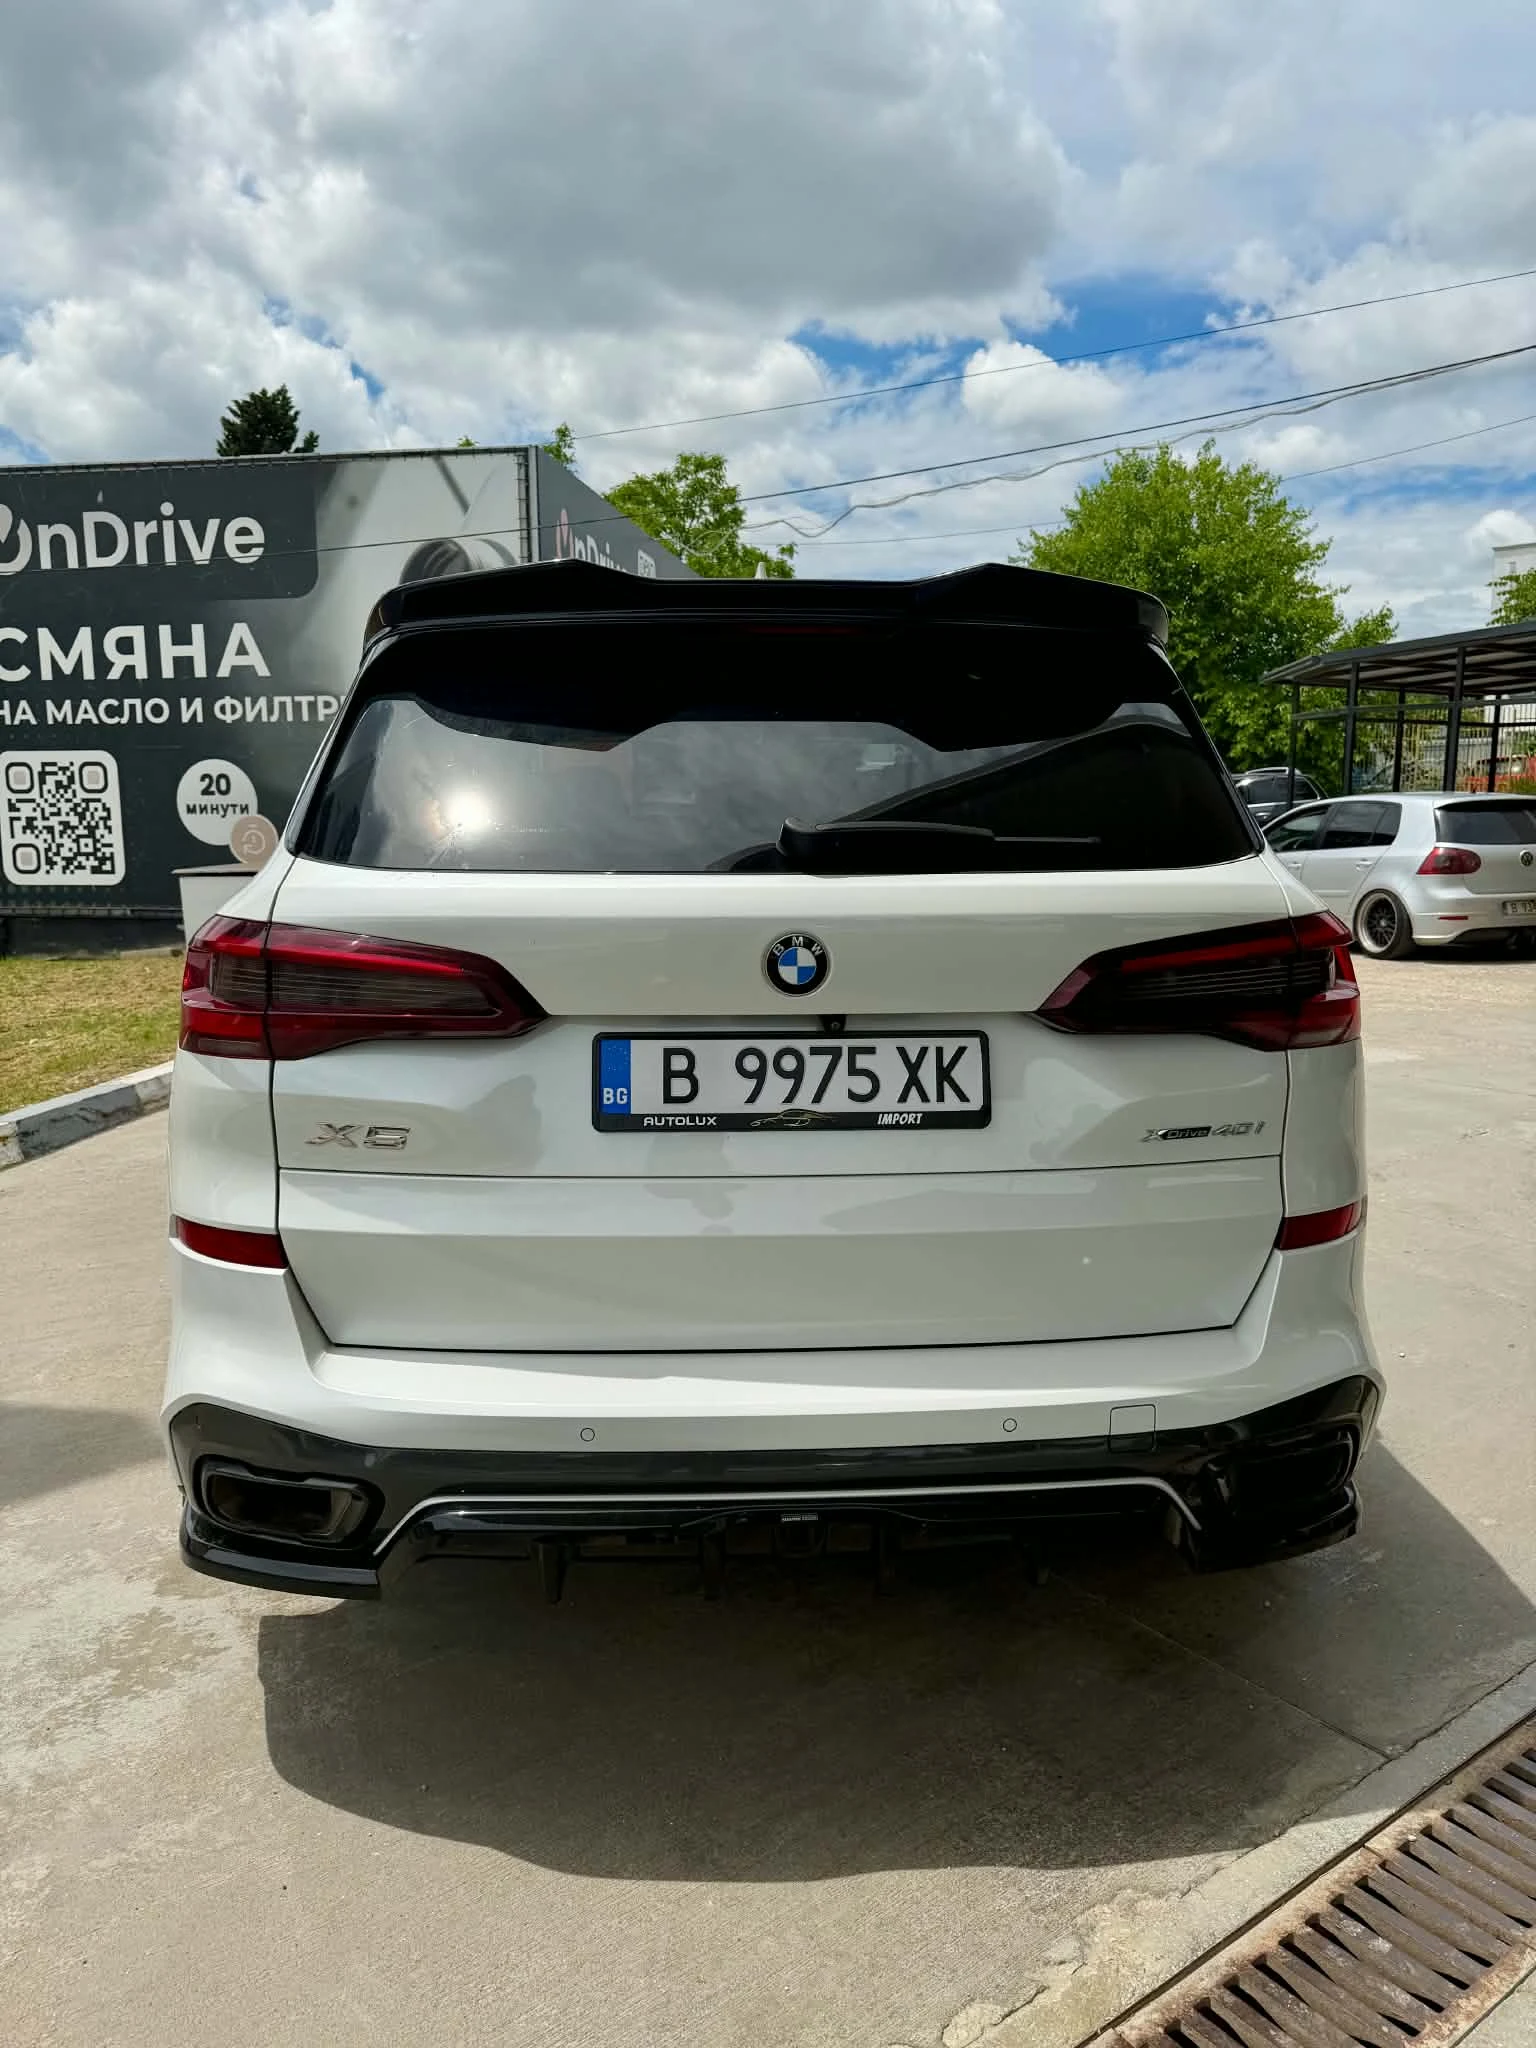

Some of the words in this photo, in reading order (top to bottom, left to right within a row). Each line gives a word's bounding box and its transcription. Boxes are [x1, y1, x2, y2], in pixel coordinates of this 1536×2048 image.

[0, 501, 266, 575] OnDrive
[0, 622, 271, 682] СМЯНА
[45, 697, 170, 725] МАСЛО
[180, 697, 204, 724] И
[213, 695, 347, 723] ФИЛТР
[200, 773, 231, 796] 20
[186, 803, 250, 818] минути
[772, 936, 824, 957] BMW
[662, 1047, 699, 1105] B
[734, 1047, 880, 1104] 9975
[896, 1046, 970, 1103] XK
[602, 1087, 629, 1105] BG
[643, 1116, 717, 1127] AUTOLUX
[877, 1112, 923, 1125] IMPORT
[304, 1121, 411, 1150] X5
